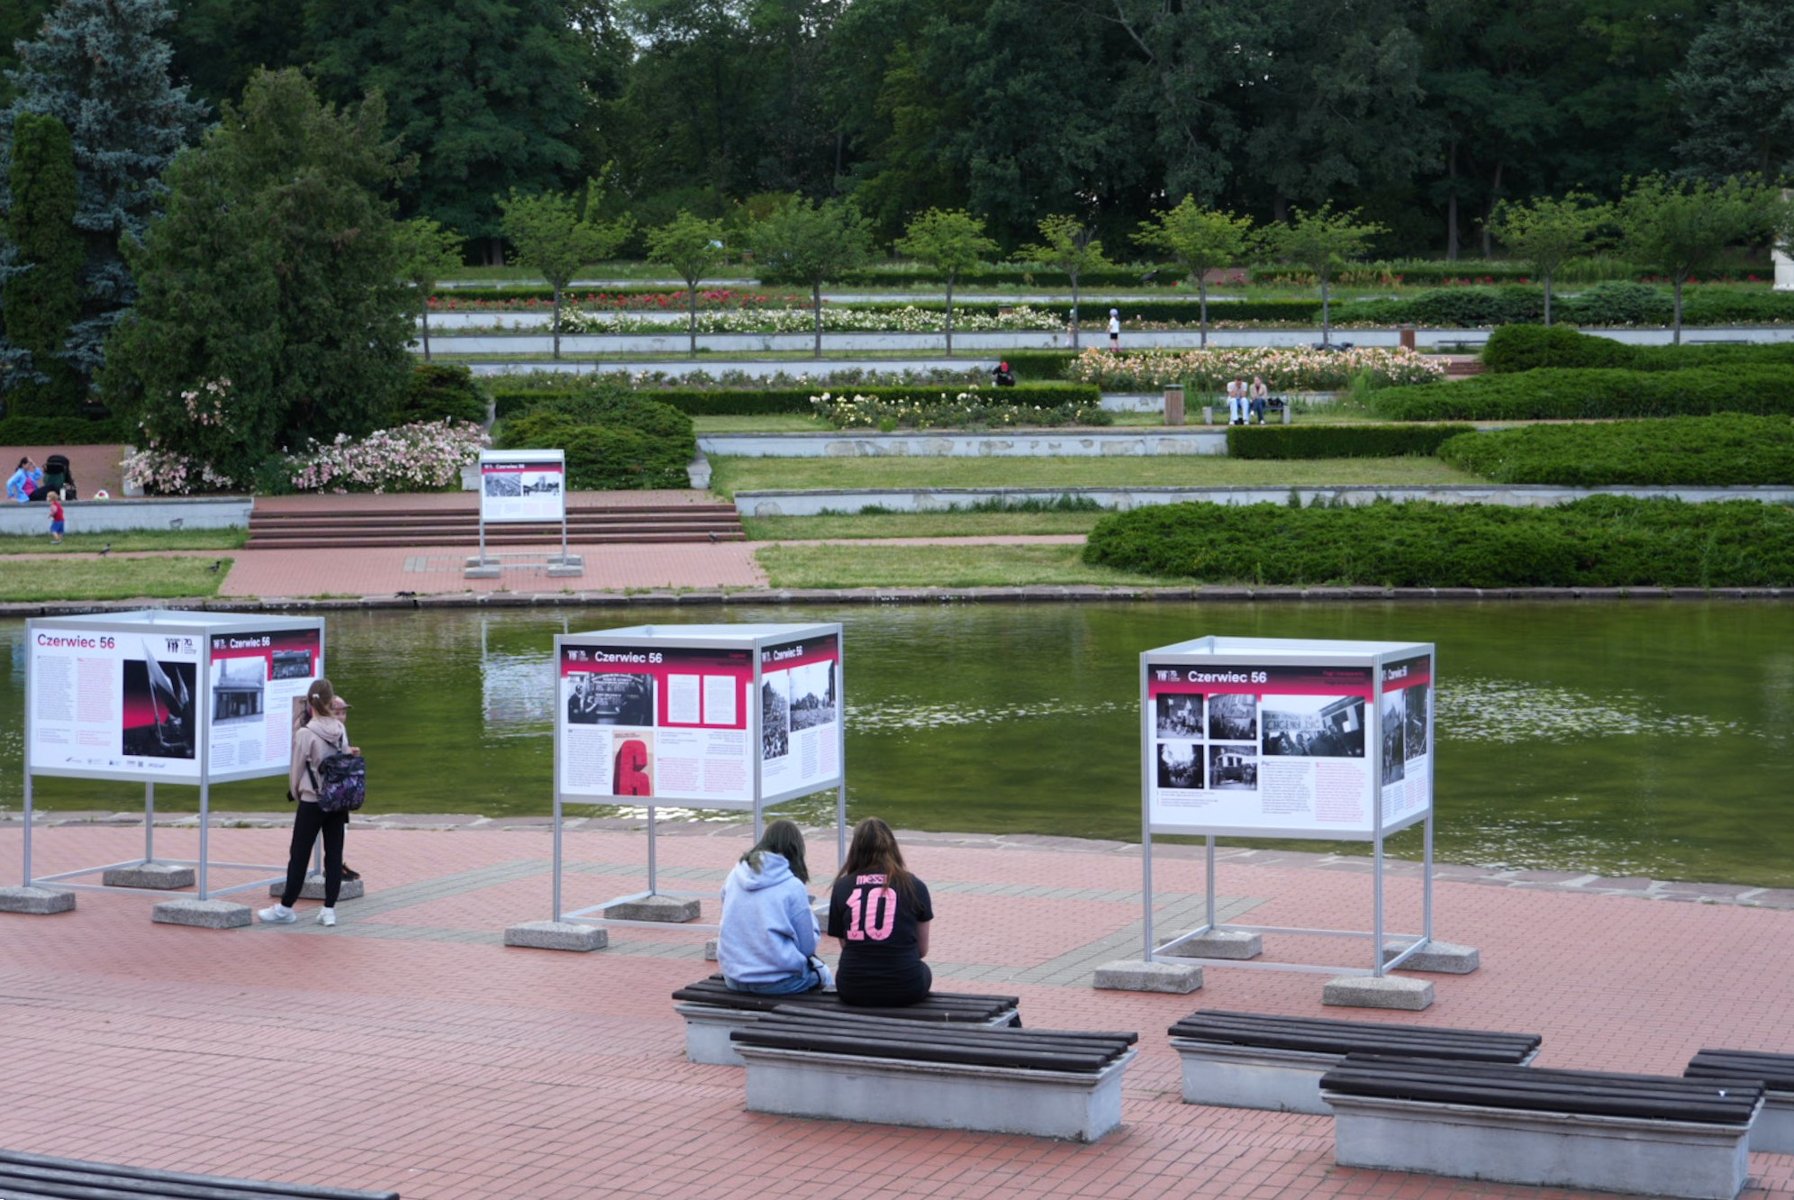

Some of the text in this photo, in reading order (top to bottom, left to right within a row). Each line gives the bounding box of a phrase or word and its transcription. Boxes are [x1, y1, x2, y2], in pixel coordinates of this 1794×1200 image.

[37, 633, 115, 649] Czerwiec 56
[229, 637, 260, 649] Czerwiec
[261, 636, 271, 647] 56
[594, 651, 646, 663] Czerwiec
[648, 652, 663, 664] 56
[773, 648, 796, 661] Czerwiec
[796, 645, 803, 656] 56
[1187, 670, 1248, 683] Czerwiec
[1250, 671, 1267, 684] 56
[846, 887, 897, 941] 10
